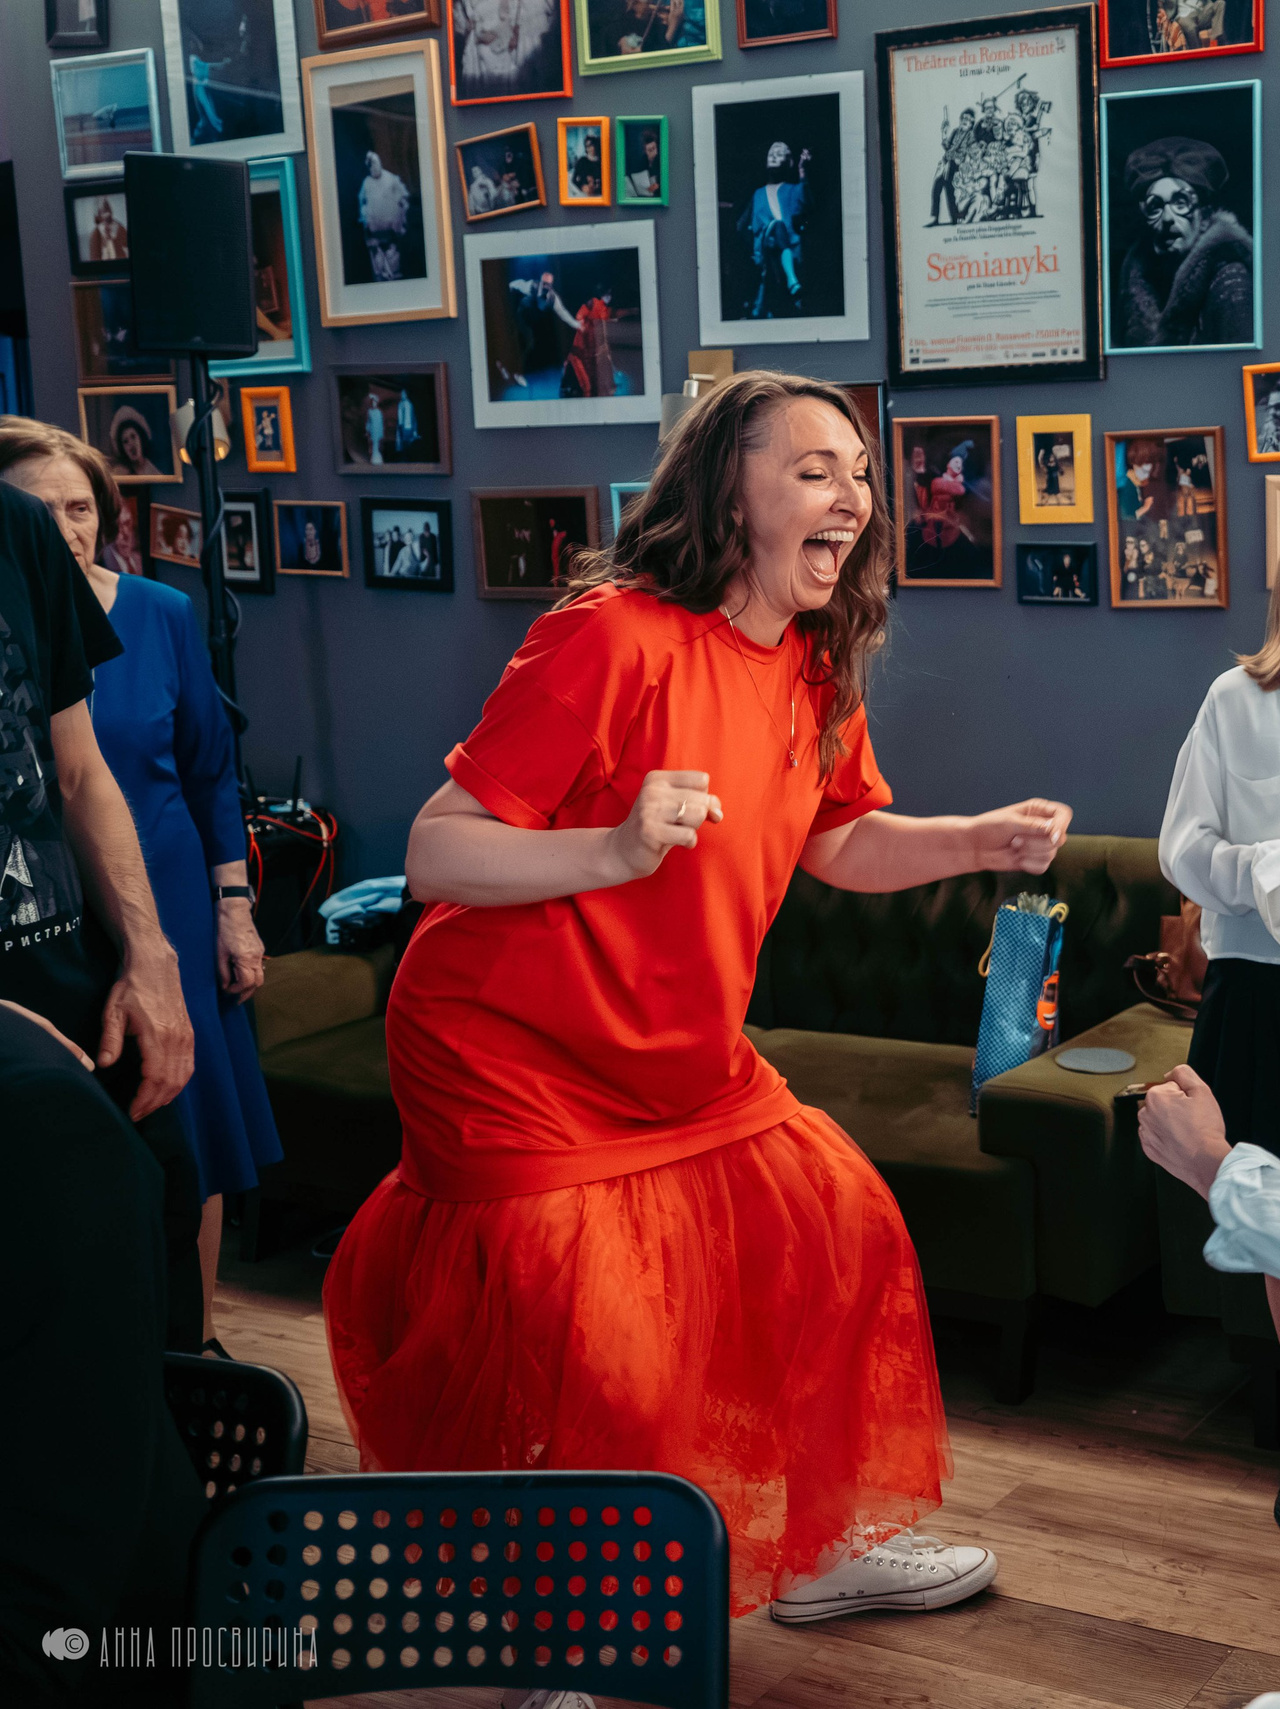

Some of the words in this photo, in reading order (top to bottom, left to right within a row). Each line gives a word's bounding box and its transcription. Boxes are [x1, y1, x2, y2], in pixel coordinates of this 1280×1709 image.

[904, 53, 956, 72] Théâtre
[959, 50, 977, 66] du
[927, 245, 1060, 286] Semianyki
